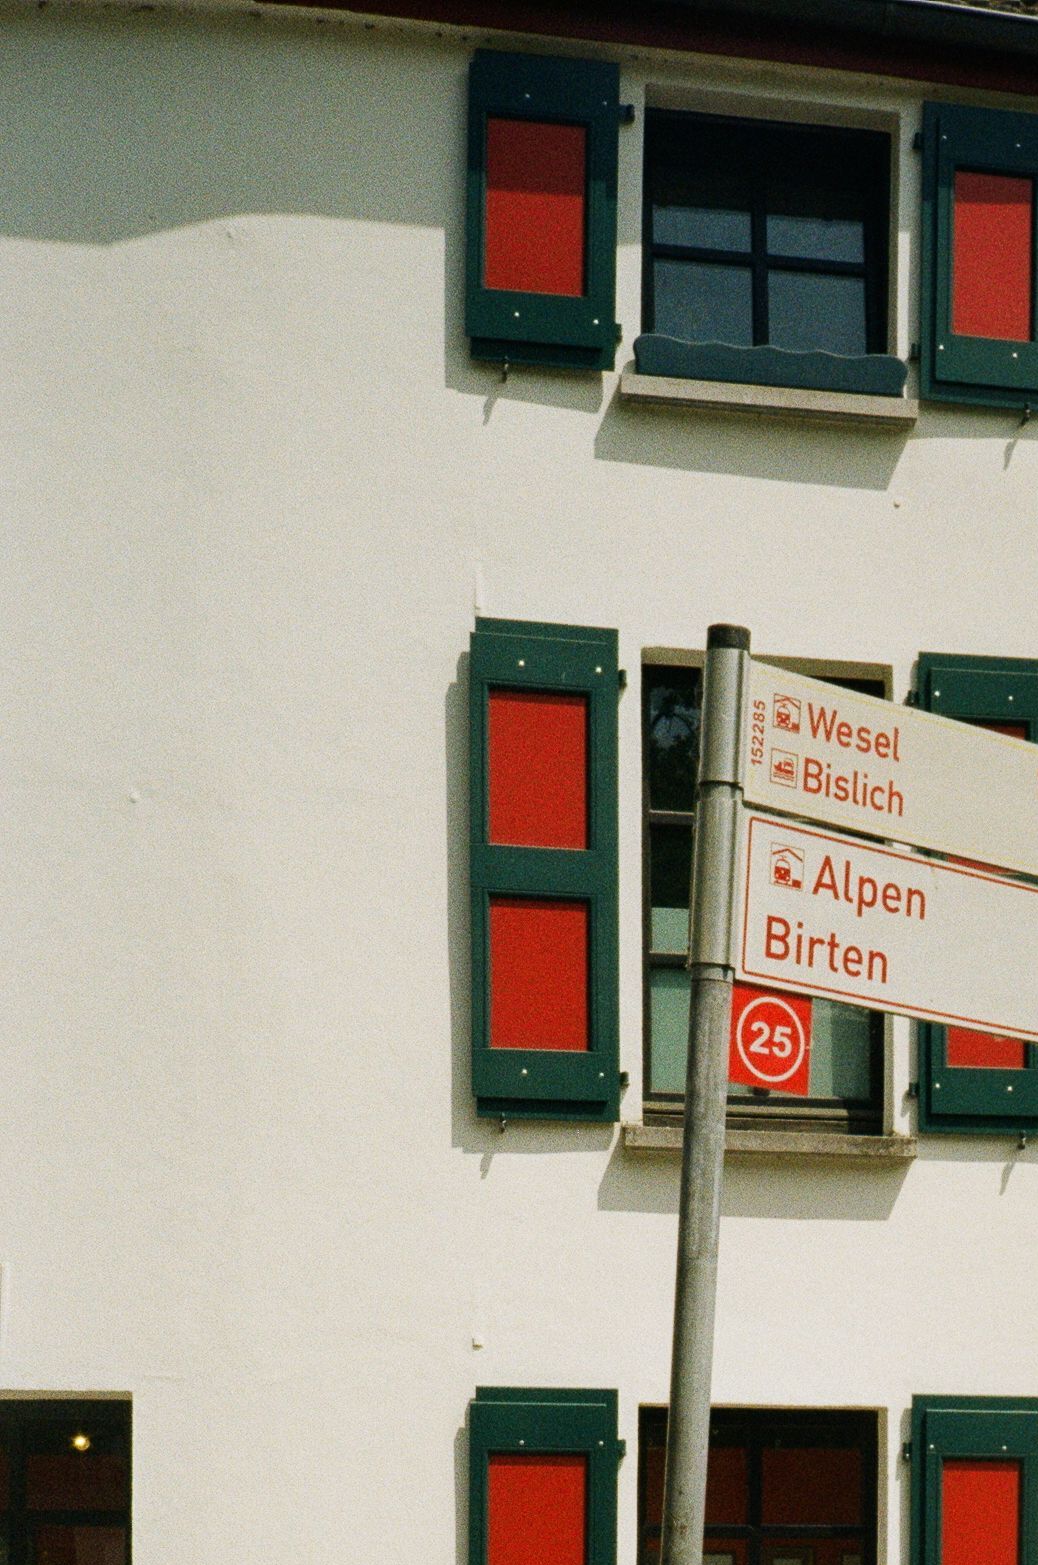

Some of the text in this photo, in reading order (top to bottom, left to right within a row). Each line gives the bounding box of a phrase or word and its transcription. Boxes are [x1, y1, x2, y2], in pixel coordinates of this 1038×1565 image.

[750, 700, 766, 766] 152285
[807, 702, 900, 763] Wesel
[803, 757, 904, 817] Bislich
[812, 855, 926, 920] Alpen
[765, 915, 888, 984] Birten
[749, 1021, 792, 1058] 25
